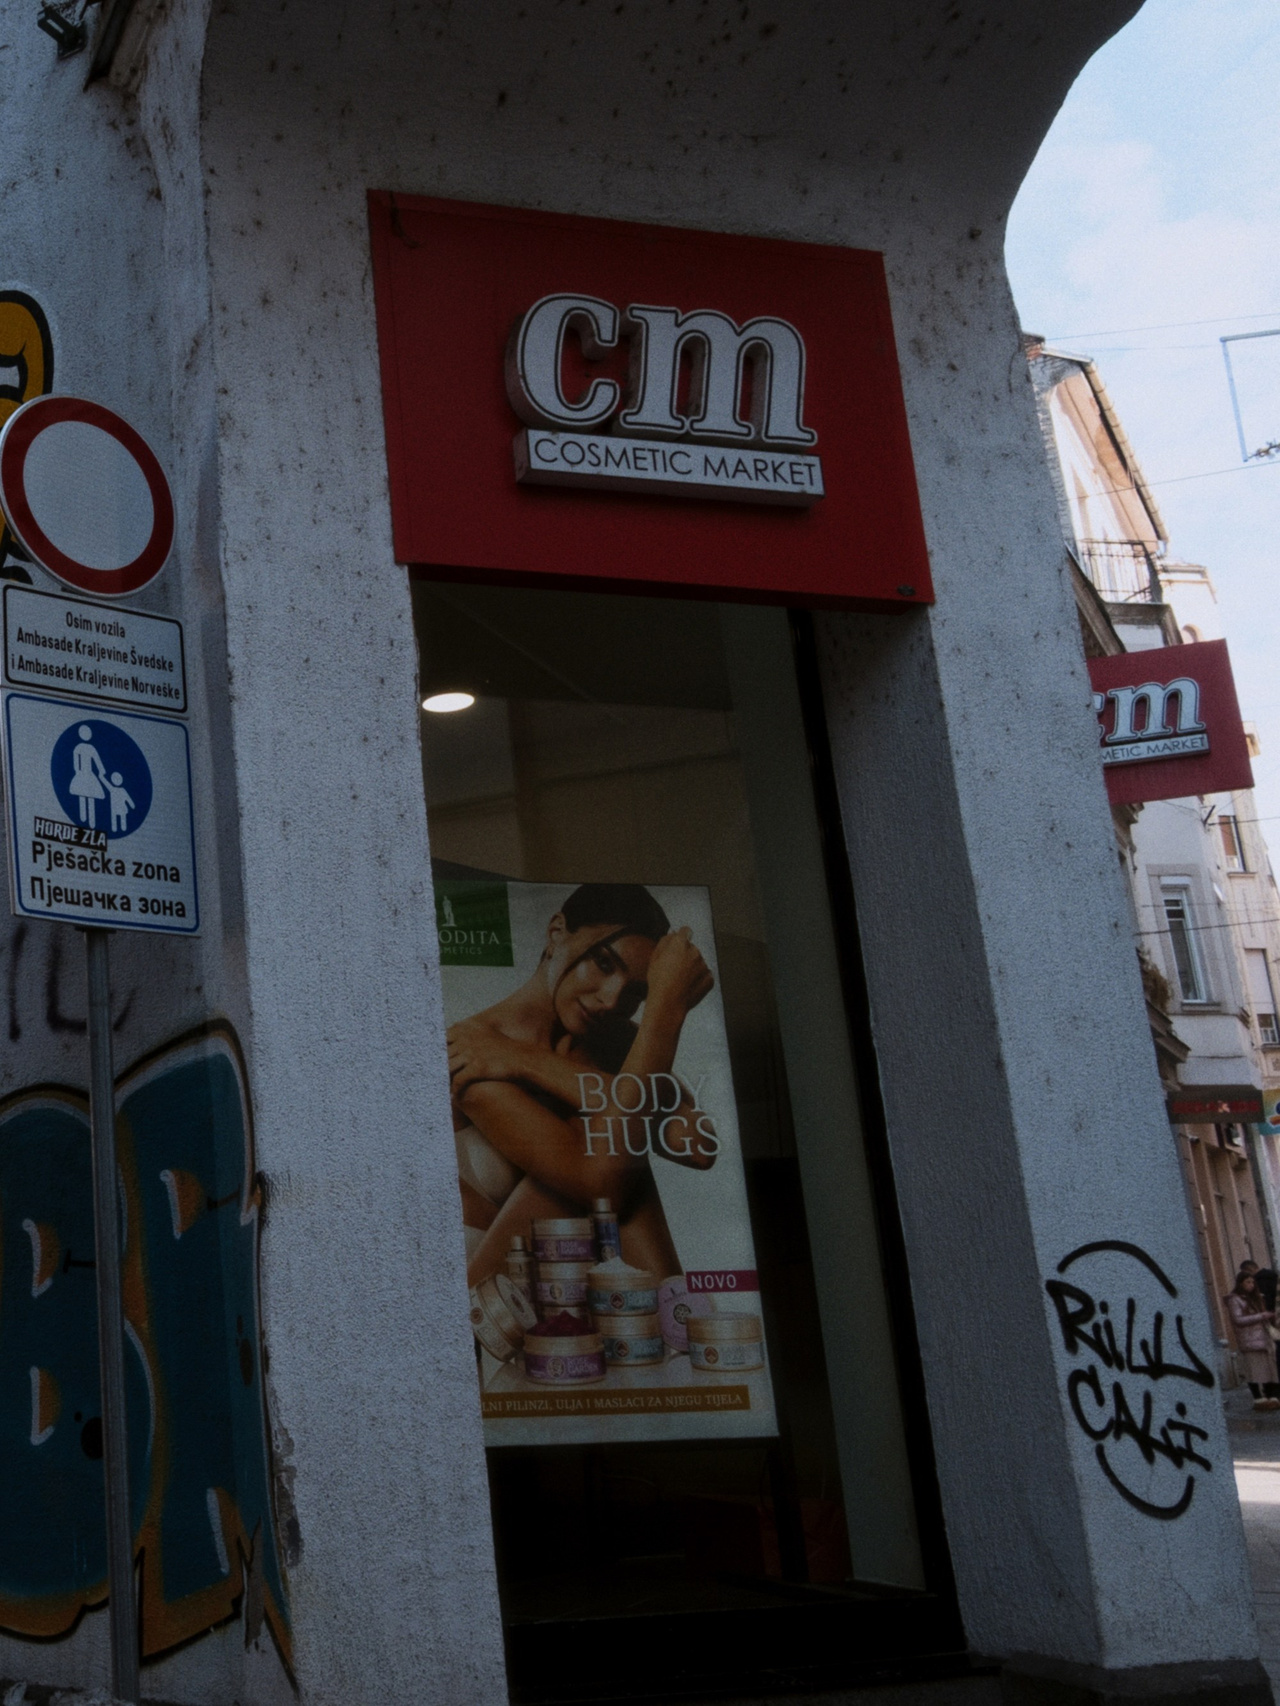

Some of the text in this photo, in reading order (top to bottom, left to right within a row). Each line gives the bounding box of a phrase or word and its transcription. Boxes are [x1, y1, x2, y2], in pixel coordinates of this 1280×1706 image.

[513, 292, 818, 447] cm
[533, 437, 817, 488] COSMETIC MARKET
[65, 611, 126, 638] Osim vozila
[16, 626, 174, 672] Ambasade Kraljevine Švedske
[11, 654, 181, 700] i Ambasade Kraljevine Norveške
[1093, 677, 1207, 743] m
[1146, 735, 1207, 755] MARKET
[34, 817, 107, 847] HORDE ZLA
[31, 840, 181, 883] Pješačka zona
[30, 875, 187, 918] Пјешачка зона
[575, 1072, 708, 1114] BODY
[580, 1115, 721, 1158] HUGS
[690, 1273, 738, 1290] NOVO
[556, 1396, 584, 1410] ULJA
[594, 1395, 645, 1410] MASLACI
[647, 1395, 663, 1408] ZA
[665, 1394, 702, 1408] NJEGU
[705, 1393, 743, 1407] TIJELA
